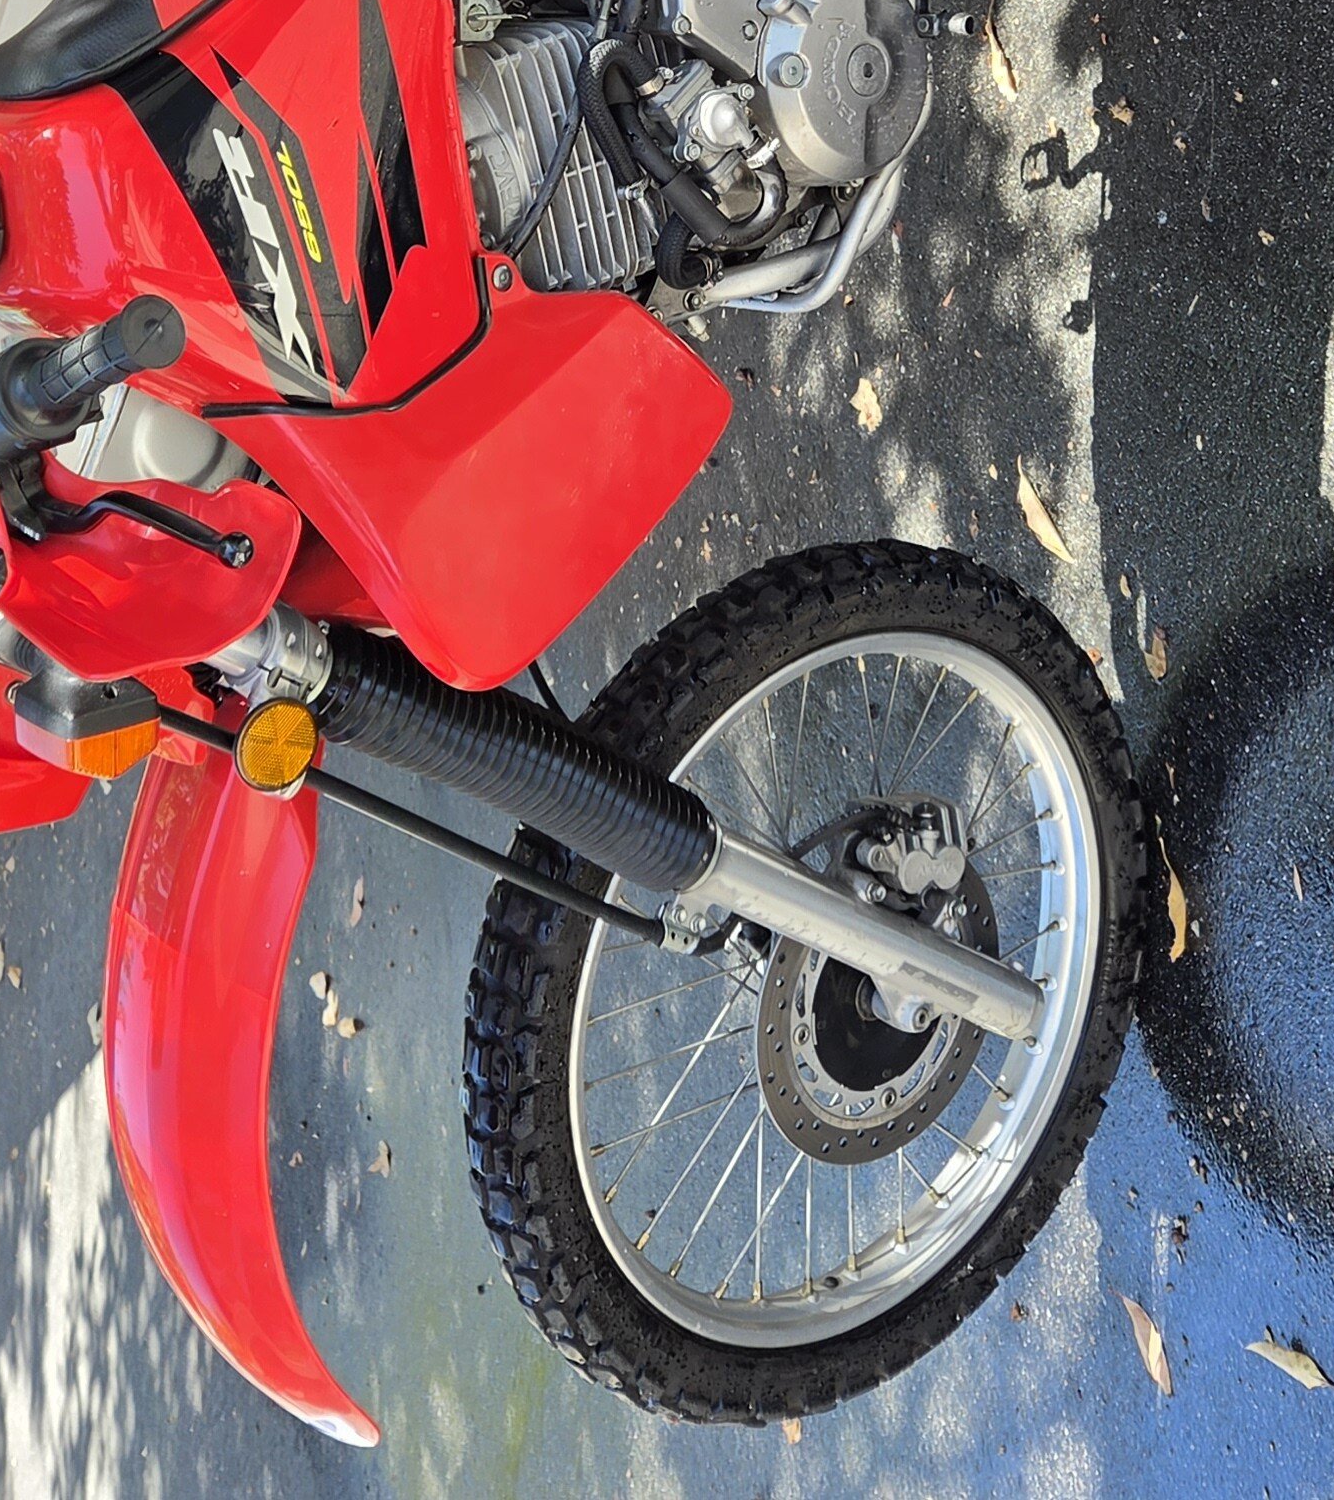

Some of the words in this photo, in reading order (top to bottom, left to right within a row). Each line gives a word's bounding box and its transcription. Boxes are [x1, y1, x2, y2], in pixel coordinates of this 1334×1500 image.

[822, 20, 857, 125] HONDA
[212, 128, 316, 374] XR
[276, 140, 323, 263] 650L
